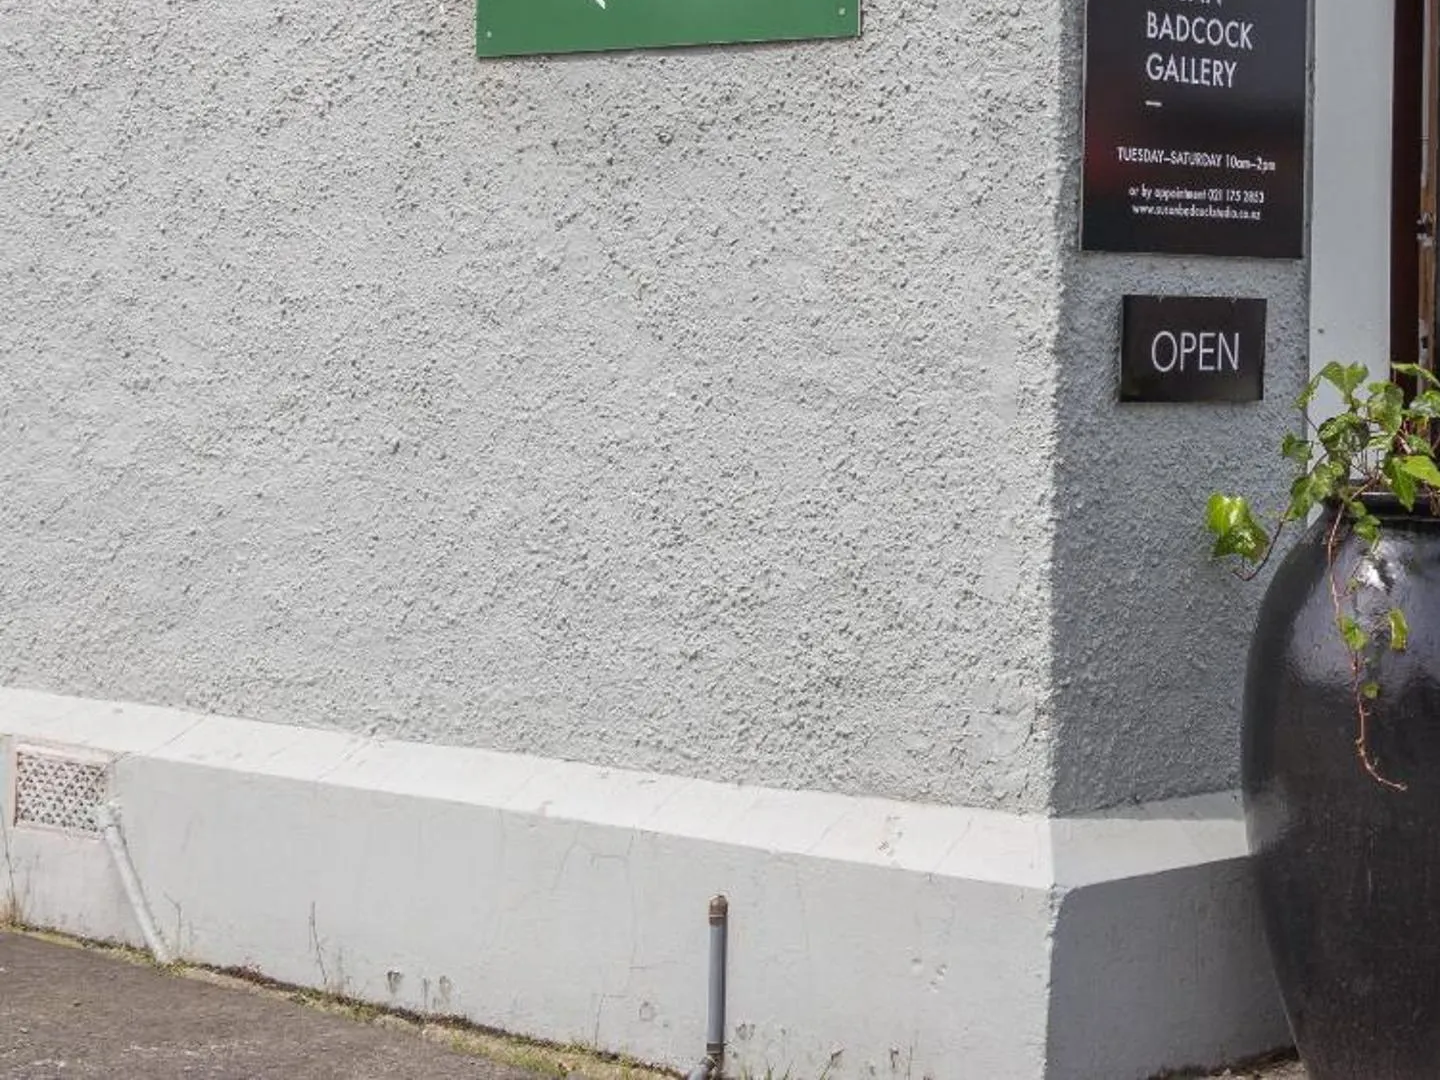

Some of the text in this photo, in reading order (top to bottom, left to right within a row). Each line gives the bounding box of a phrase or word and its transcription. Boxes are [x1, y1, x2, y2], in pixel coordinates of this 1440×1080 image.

[1146, 10, 1254, 50] BADCOCK
[1146, 52, 1238, 89] GALLERY
[1128, 186, 1139, 196] or
[1141, 183, 1152, 200] by
[1154, 186, 1206, 201] appointment
[1151, 330, 1240, 373] OPEN
